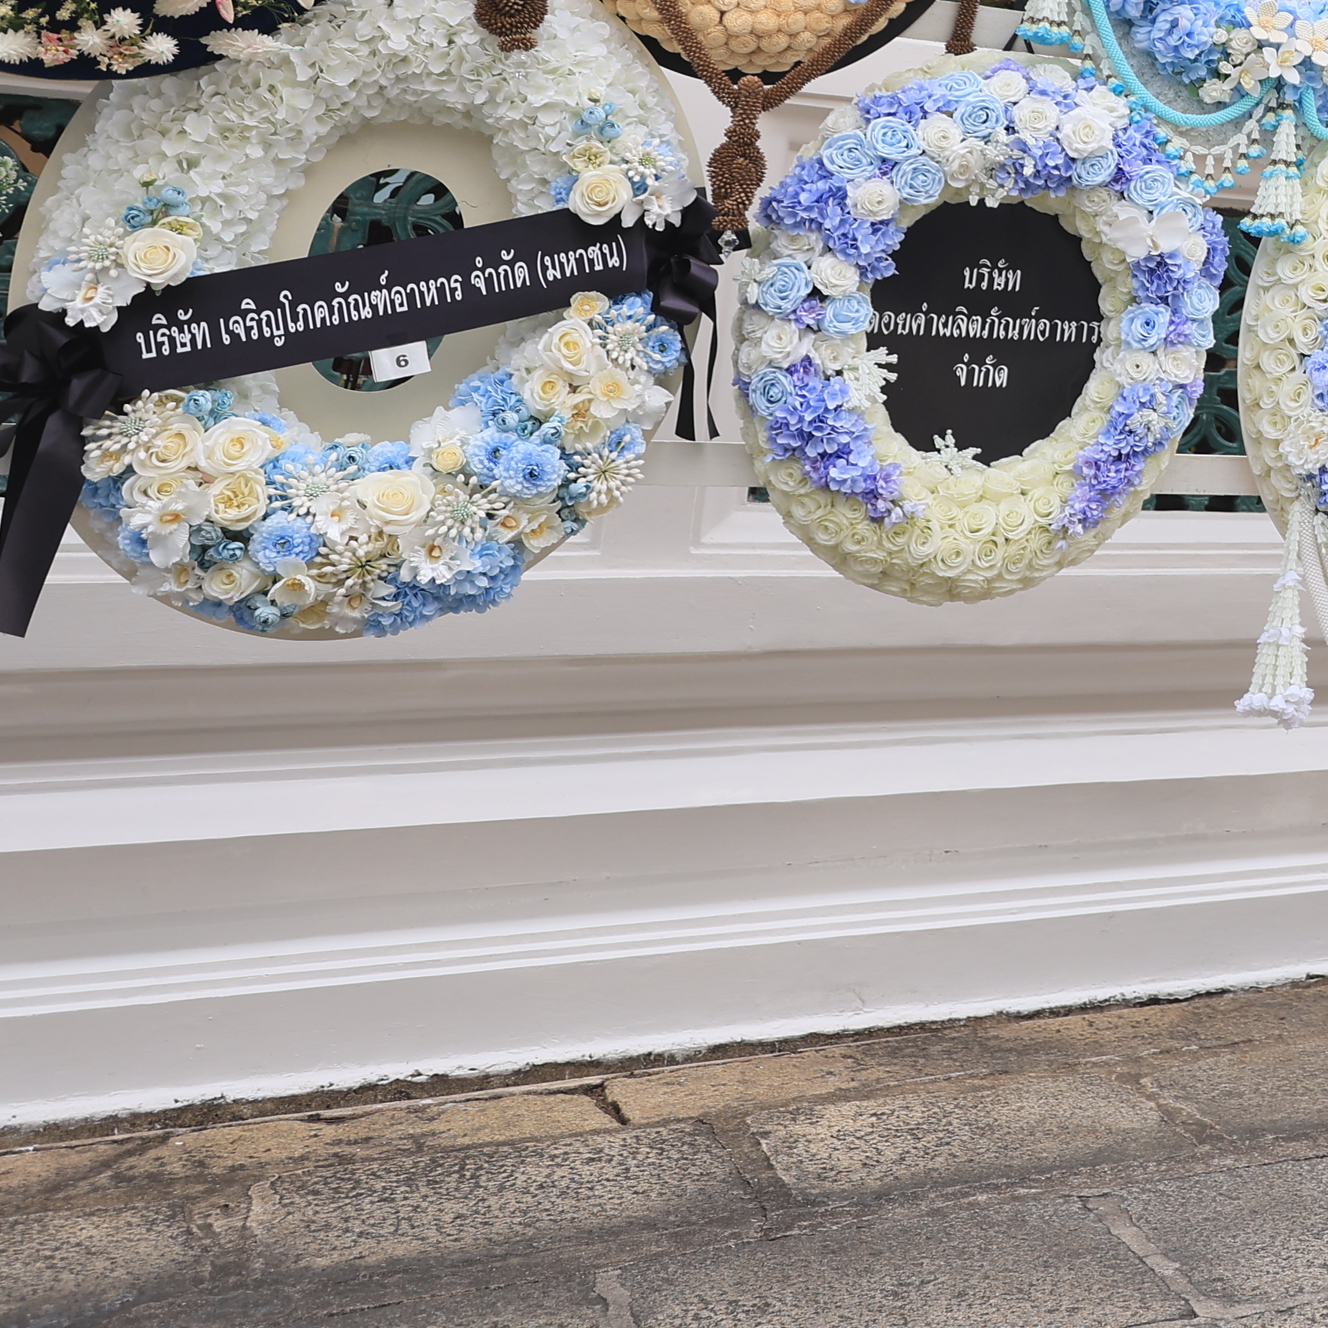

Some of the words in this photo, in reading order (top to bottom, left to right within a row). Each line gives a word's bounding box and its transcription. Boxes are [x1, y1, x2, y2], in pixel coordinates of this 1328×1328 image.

[963, 259, 1022, 292] บริษัท
[136, 308, 211, 360] บริษัท
[221, 270, 463, 347] เจริญโภคภัณฑ์อาหาร
[470, 250, 531, 297] จำกัด
[537, 235, 628, 289] (มหาชน)
[866, 302, 1101, 344] ดอยคำผลิตภัณฑ์อาหาร
[396, 354, 409, 369] 6
[952, 353, 1009, 388] จำกัด
